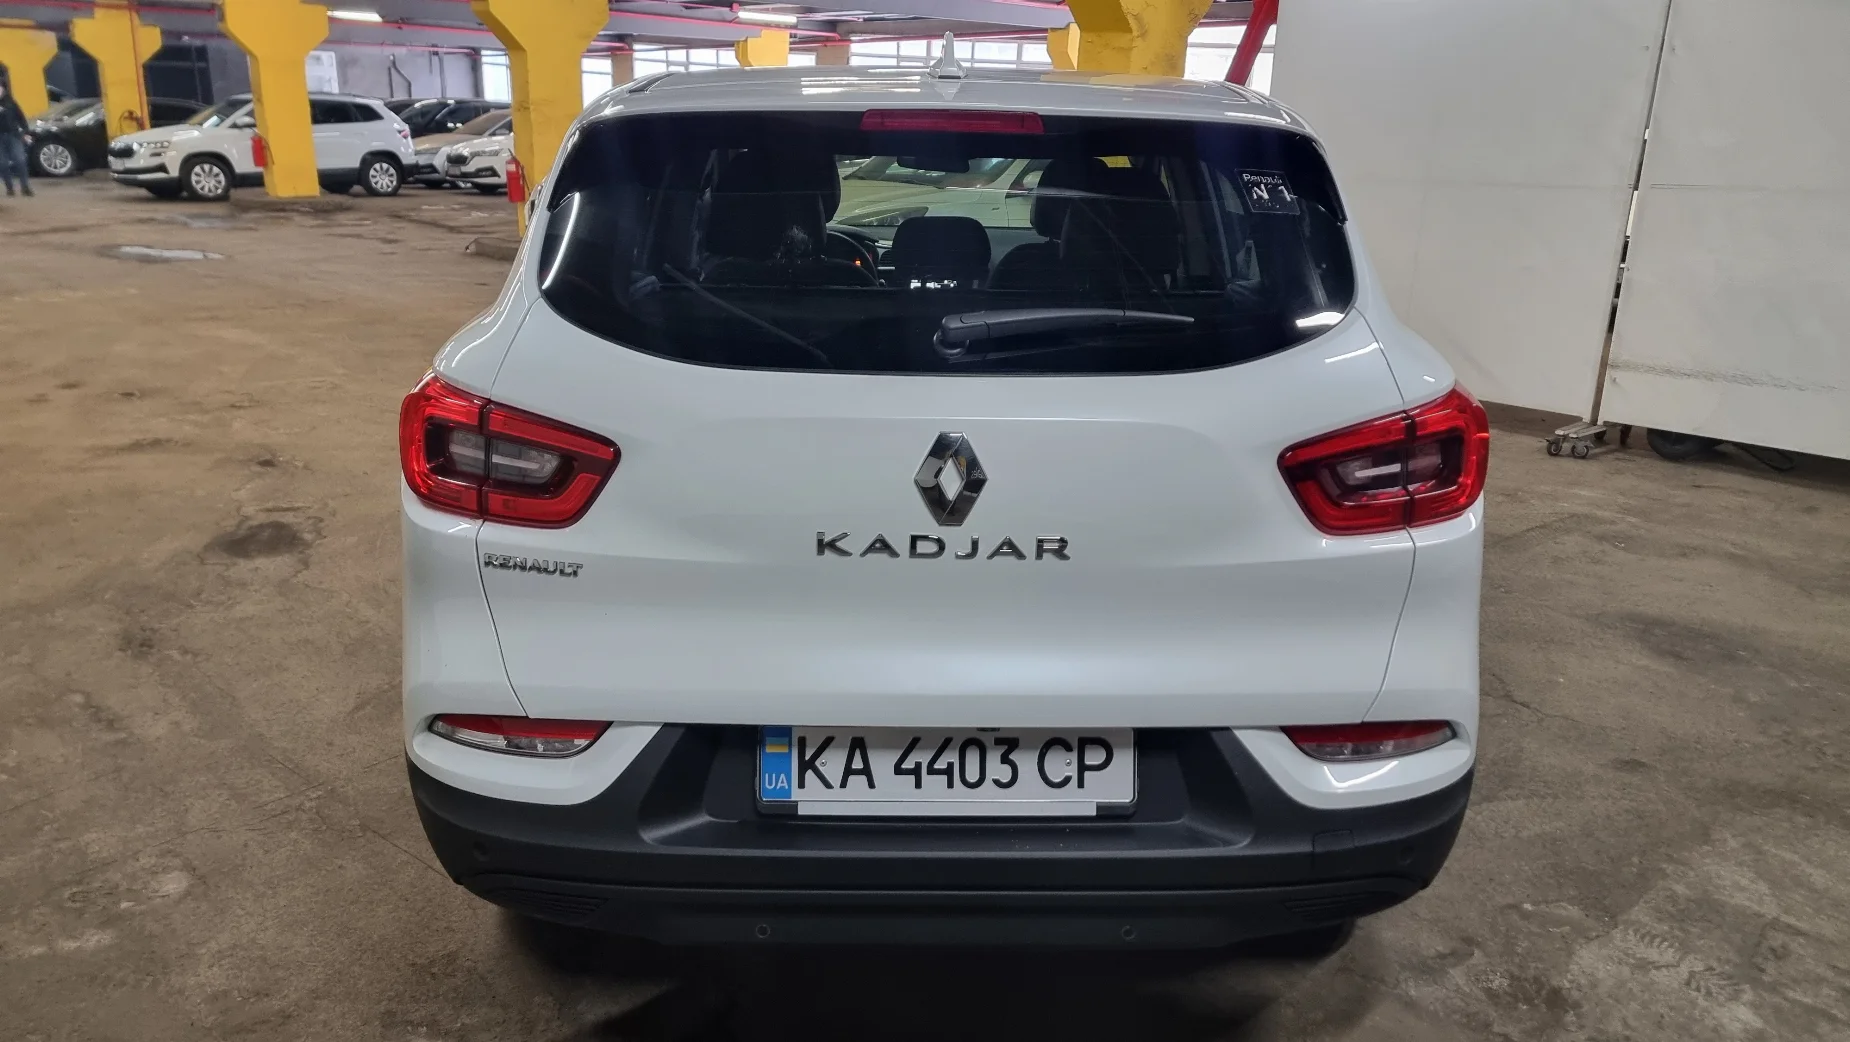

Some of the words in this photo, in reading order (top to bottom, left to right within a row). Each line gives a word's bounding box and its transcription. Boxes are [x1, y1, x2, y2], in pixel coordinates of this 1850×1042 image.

[815, 532, 1071, 561] KADJAR
[484, 552, 584, 577] RENAULT
[797, 736, 876, 790] KA
[893, 736, 1020, 790] 4403
[1036, 736, 1114, 790] CP
[765, 773, 789, 790] UA
